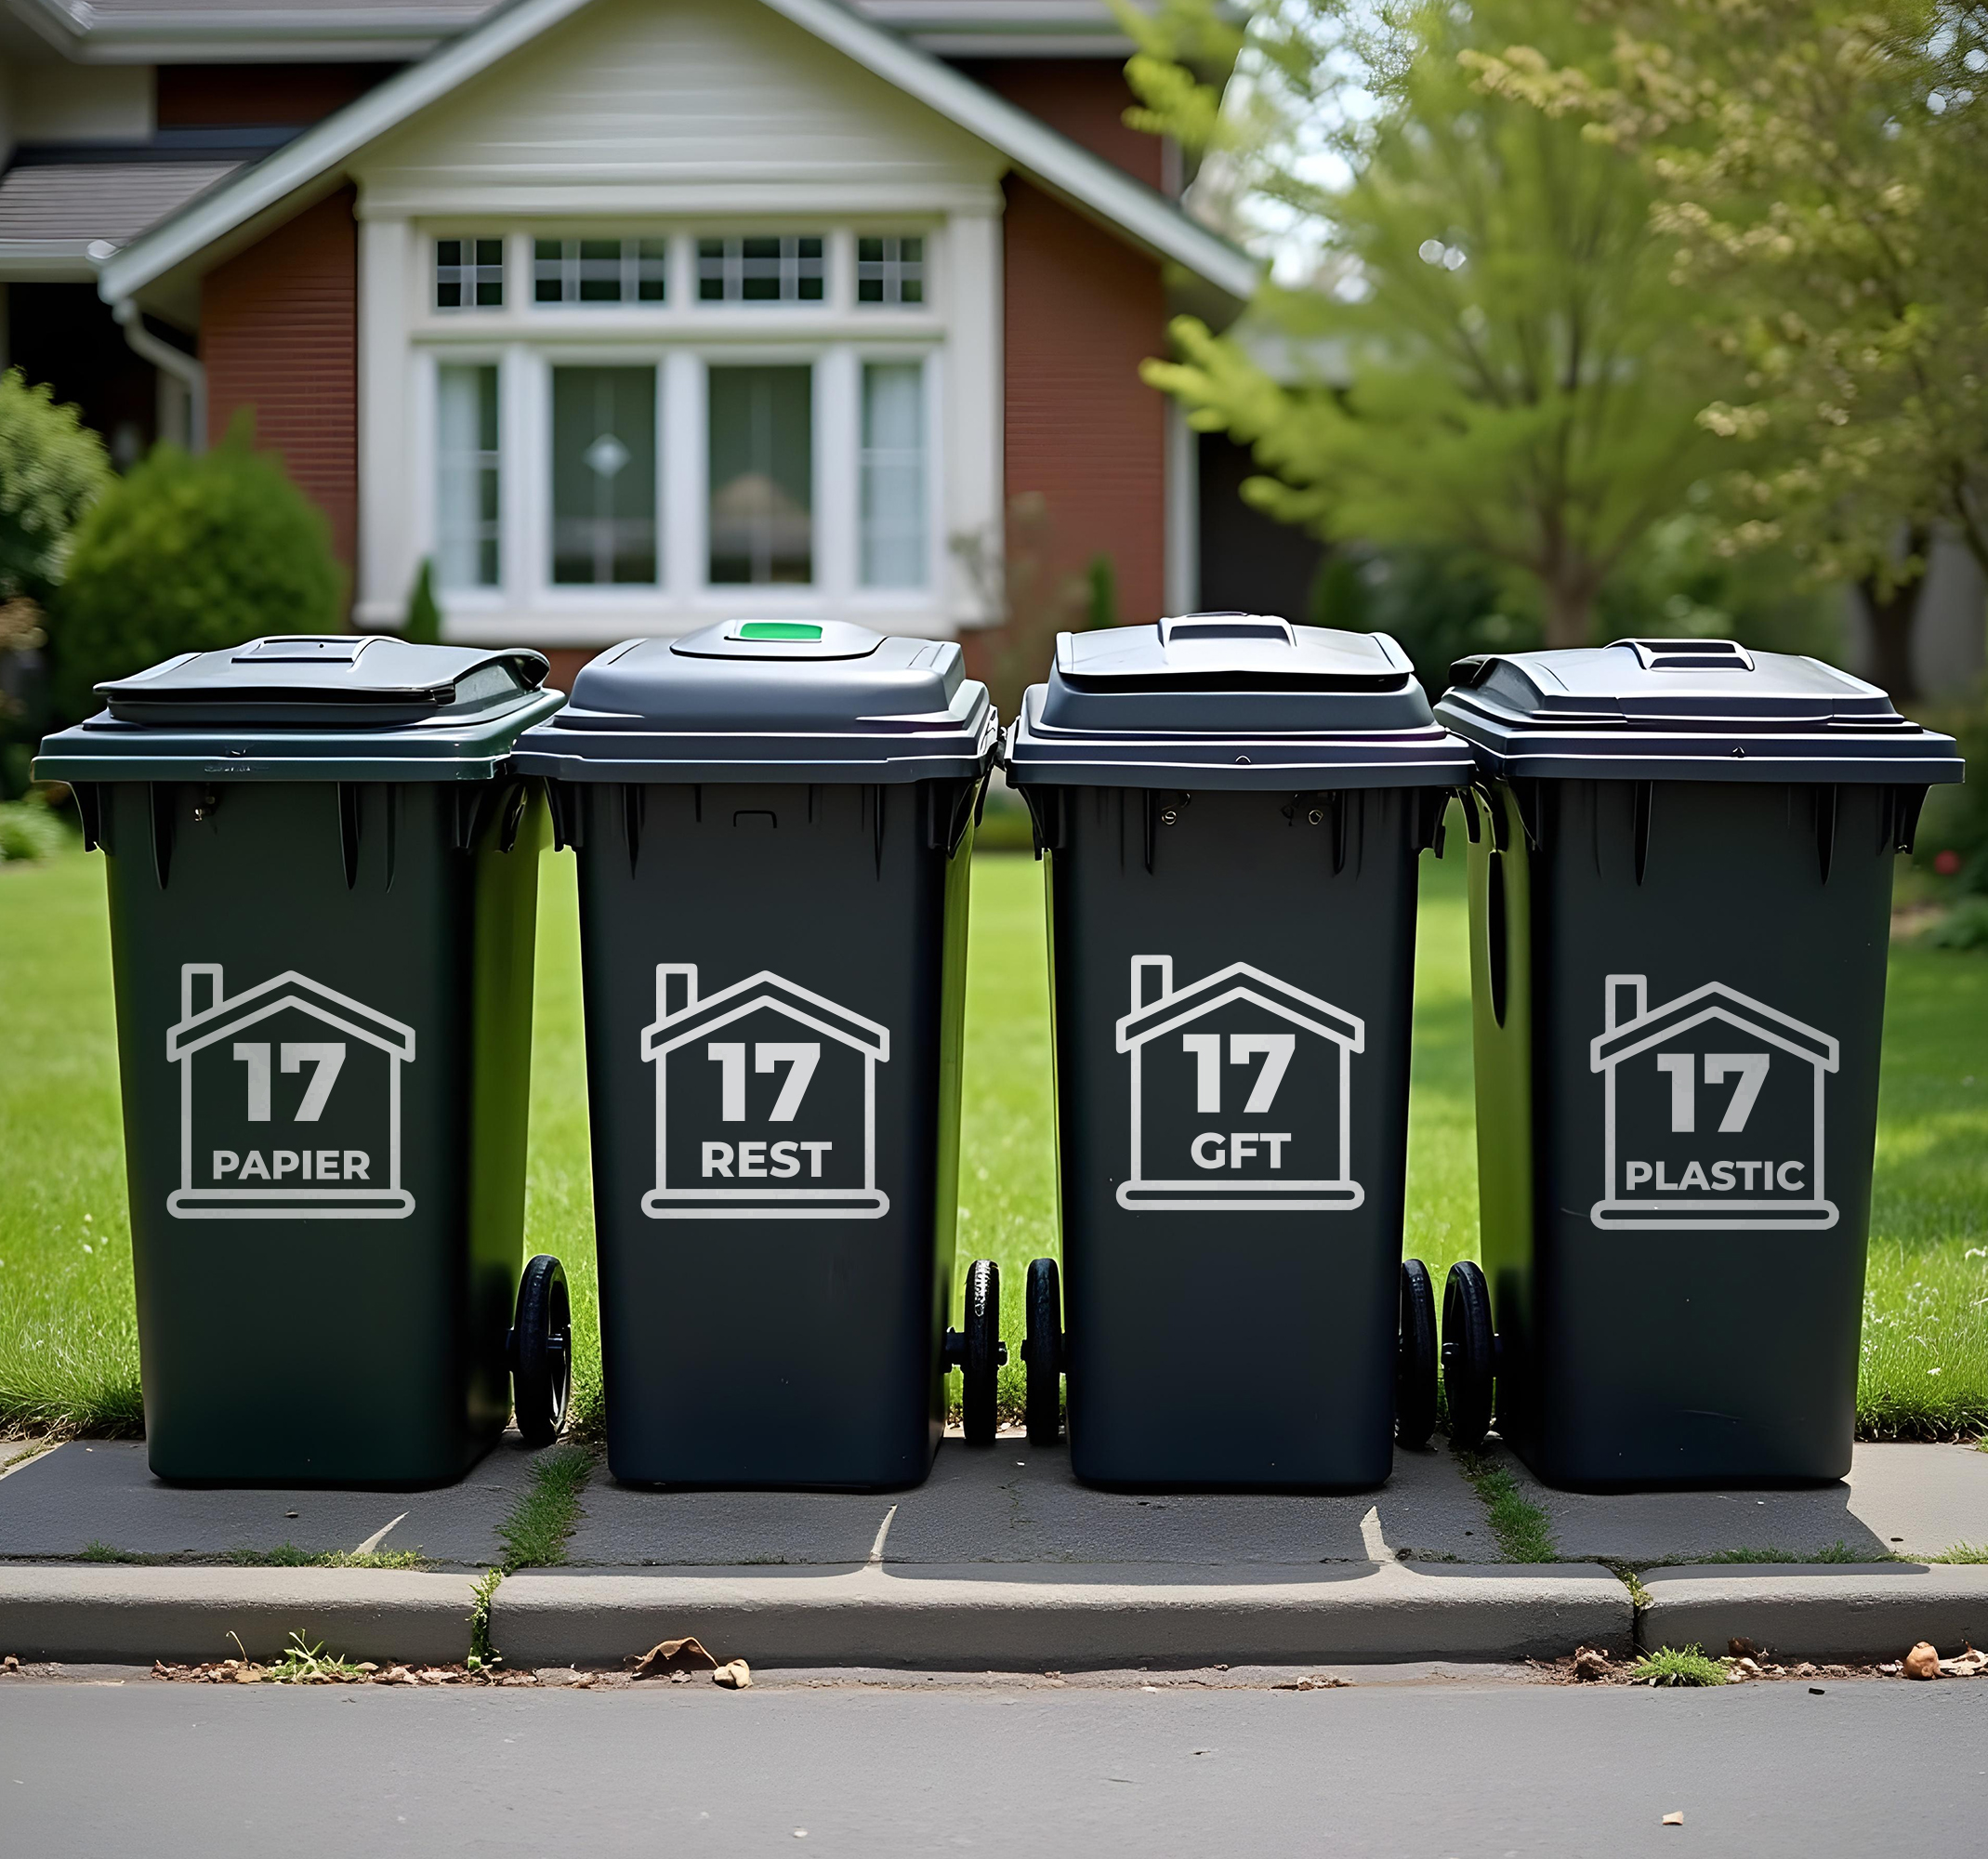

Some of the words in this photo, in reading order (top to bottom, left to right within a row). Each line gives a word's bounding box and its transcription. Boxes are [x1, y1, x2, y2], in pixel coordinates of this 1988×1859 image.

[233, 1042, 347, 1122] 17
[707, 1042, 821, 1122] 17
[1182, 1034, 1296, 1114] 17
[1656, 1053, 1771, 1133] 17
[213, 1150, 371, 1180] PAPIER
[702, 1140, 833, 1179] REST
[1191, 1131, 1292, 1169] GFT
[1626, 1160, 1806, 1192] PLASTIC
